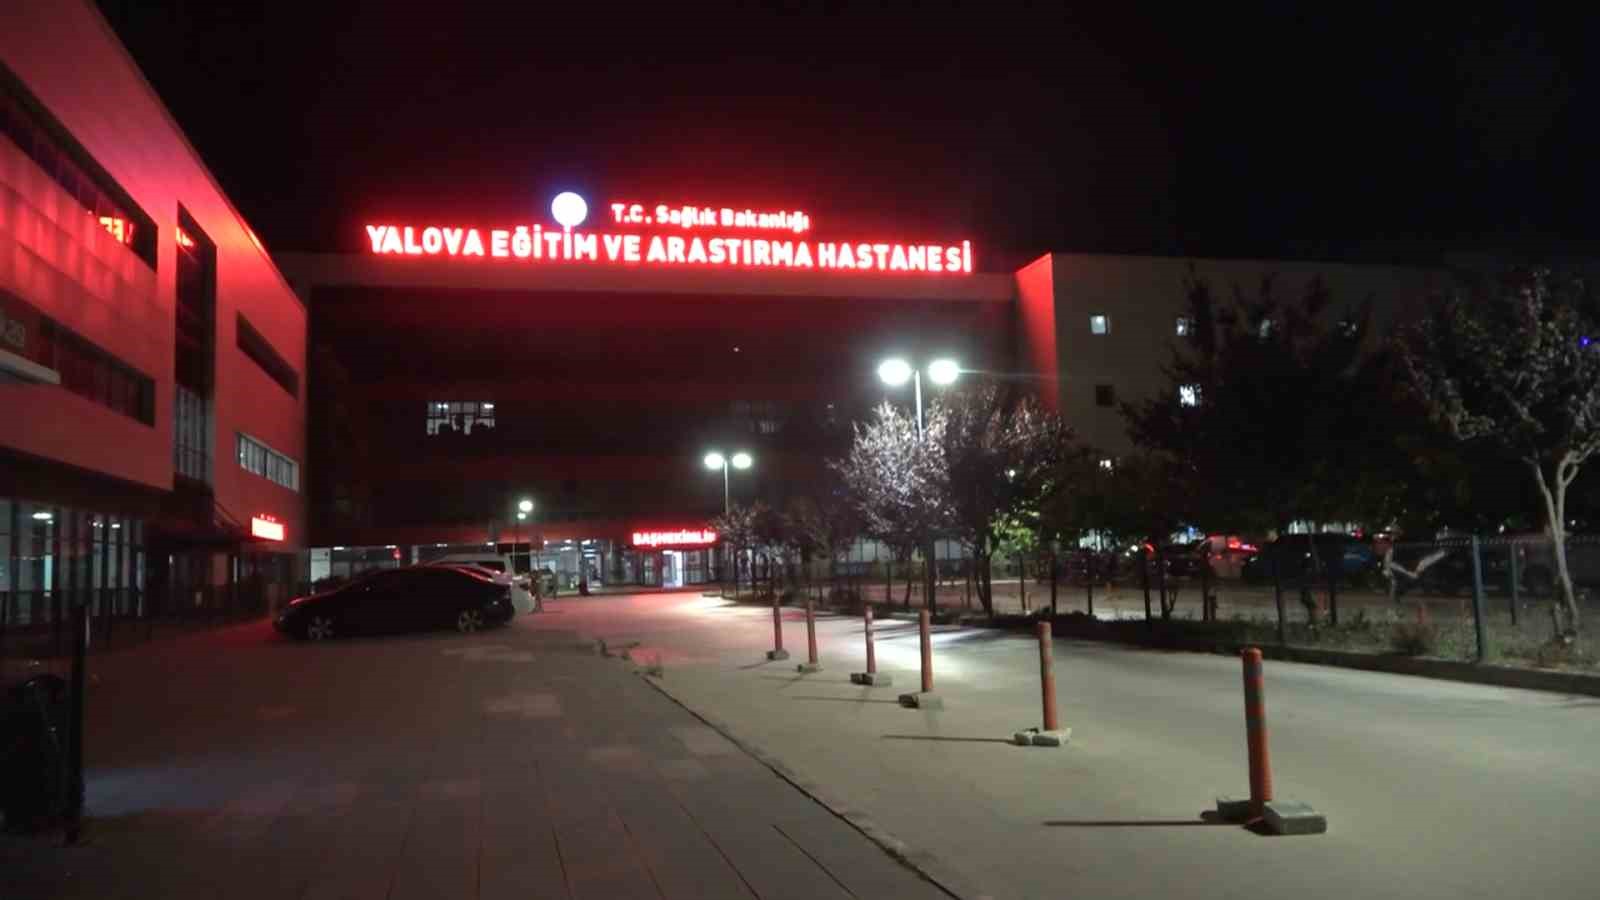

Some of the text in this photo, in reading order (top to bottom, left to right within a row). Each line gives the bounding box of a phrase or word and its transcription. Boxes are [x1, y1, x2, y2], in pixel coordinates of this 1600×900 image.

[611, 203, 810, 233] T.C. Sağlık Bakanlığı
[366, 225, 485, 256] YALOVA
[491, 225, 598, 260] EĞİTİM
[603, 234, 641, 262] VE
[818, 240, 972, 272] HASTANESİ
